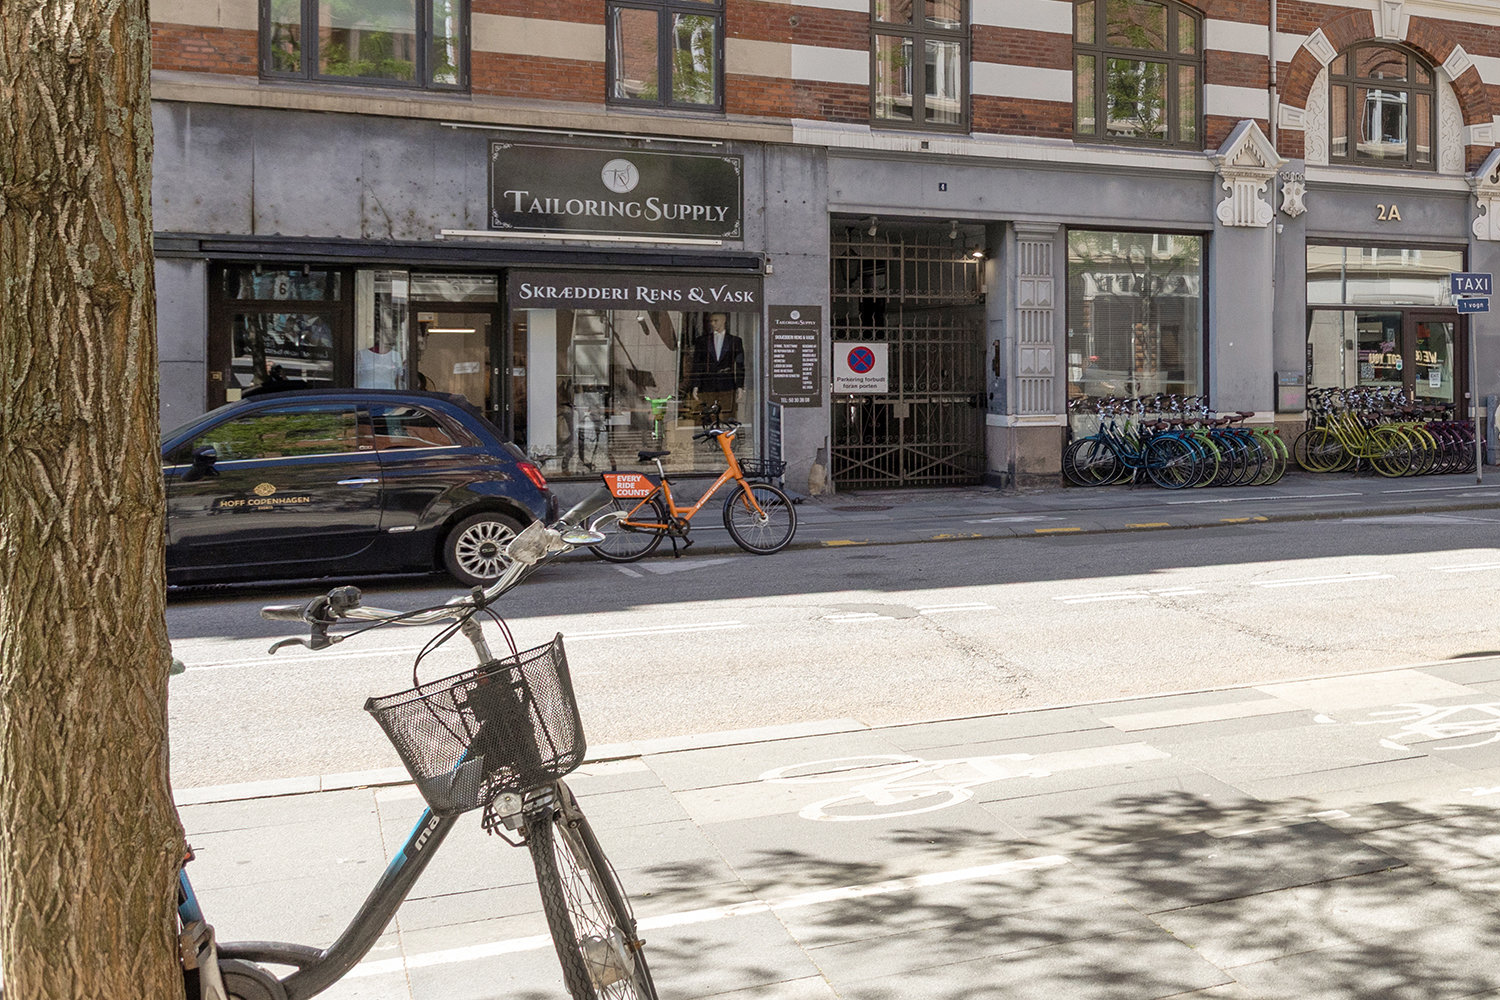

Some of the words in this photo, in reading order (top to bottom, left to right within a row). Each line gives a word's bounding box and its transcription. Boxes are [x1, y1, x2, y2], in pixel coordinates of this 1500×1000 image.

[1376, 204, 1401, 221] 2A
[279, 282, 287, 295] 6
[1455, 278, 1488, 290] TAXI
[688, 287, 709, 304] &
[616, 489, 650, 497] COUNTS
[247, 497, 310, 506] COPENHAGEN
